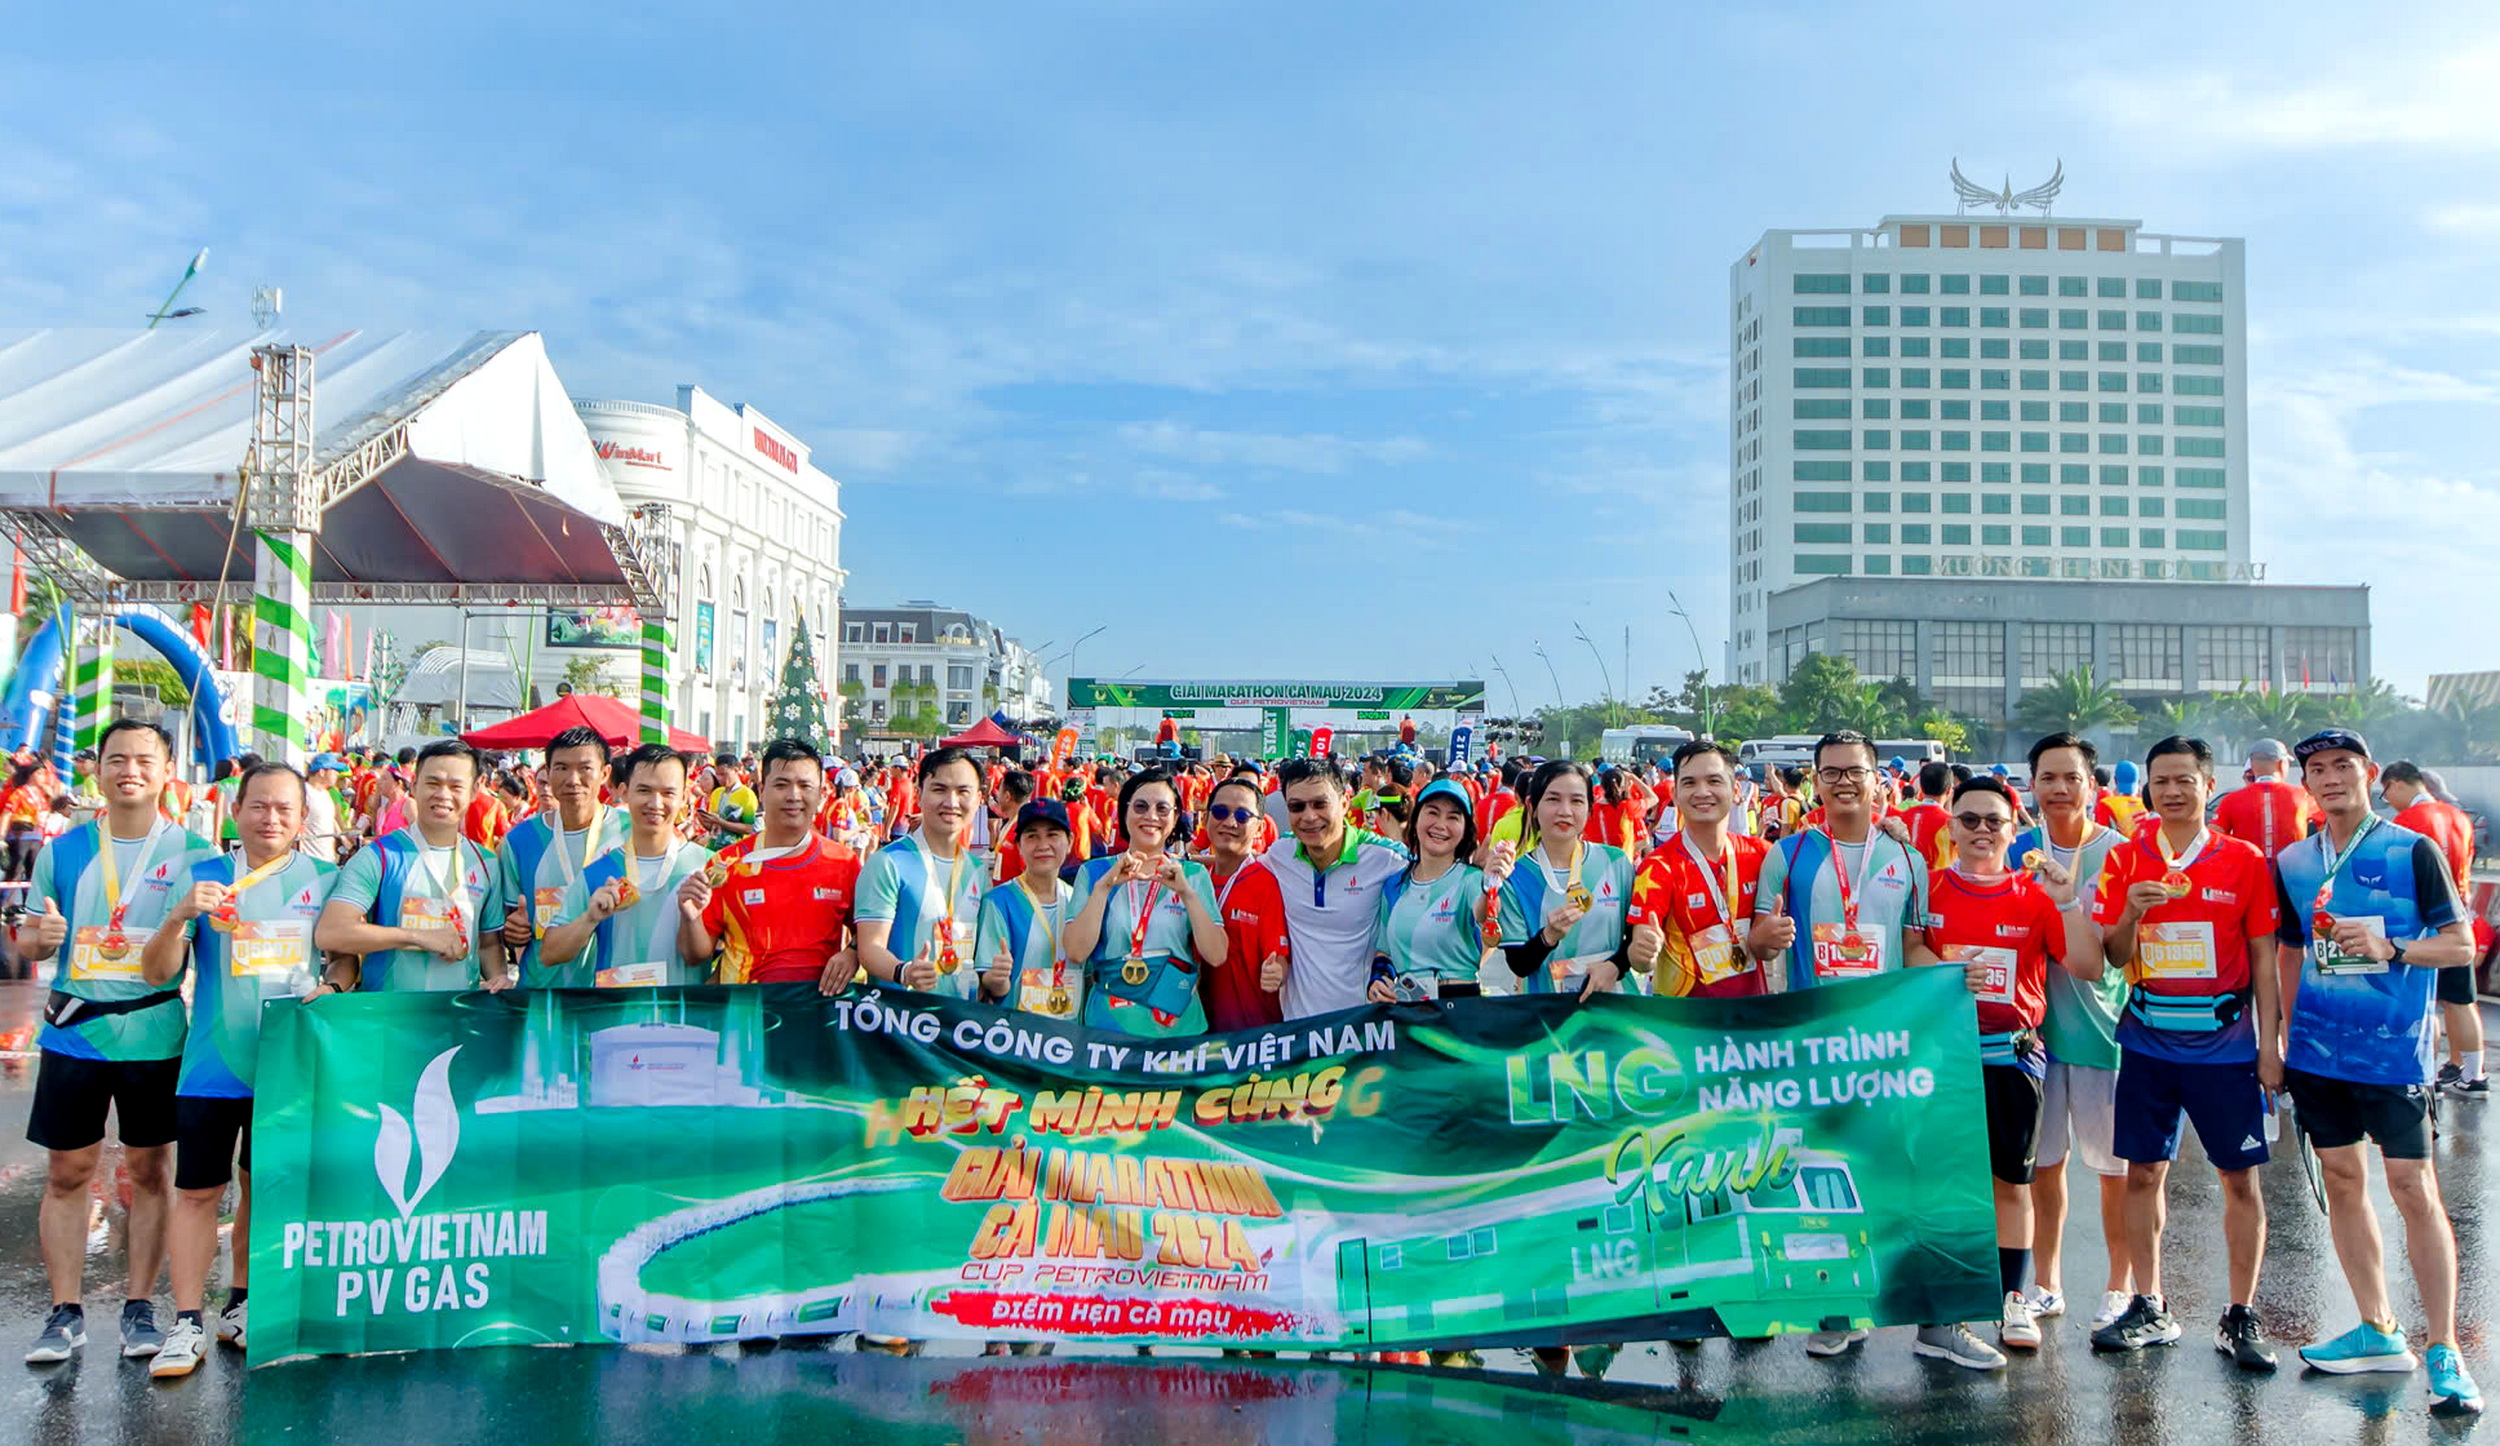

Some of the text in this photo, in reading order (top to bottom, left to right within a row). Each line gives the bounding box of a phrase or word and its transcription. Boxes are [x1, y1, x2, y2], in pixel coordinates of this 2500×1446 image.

[1205, 685, 1284, 699] MARATHON
[1310, 685, 1342, 701] MAU
[1345, 686, 1381, 701] 2024
[1263, 711, 1277, 754] START
[2317, 942, 2324, 958] B
[835, 989, 1396, 1072] TỔNG CÔNG TY KHÍ VIỆT NAM
[1695, 1026, 1909, 1072] HÀNH TRÌNH
[905, 1066, 1346, 1136] HẾT MÌNH CÙNG
[1506, 1047, 1687, 1124] LNG
[1699, 1067, 1934, 1112] NĂNG LƯỢNG
[941, 1136, 1041, 1201] GIẢI
[1604, 1118, 1803, 1215] Xanh
[283, 1211, 548, 1269] PETROVIETNAM
[1044, 1204, 1143, 1261] MAU
[1152, 1214, 1262, 1272] 2024
[1571, 1238, 1640, 1281] LNG
[336, 1263, 490, 1317] PV GAS
[961, 1263, 1271, 1292] CUP PETROVIETNAM
